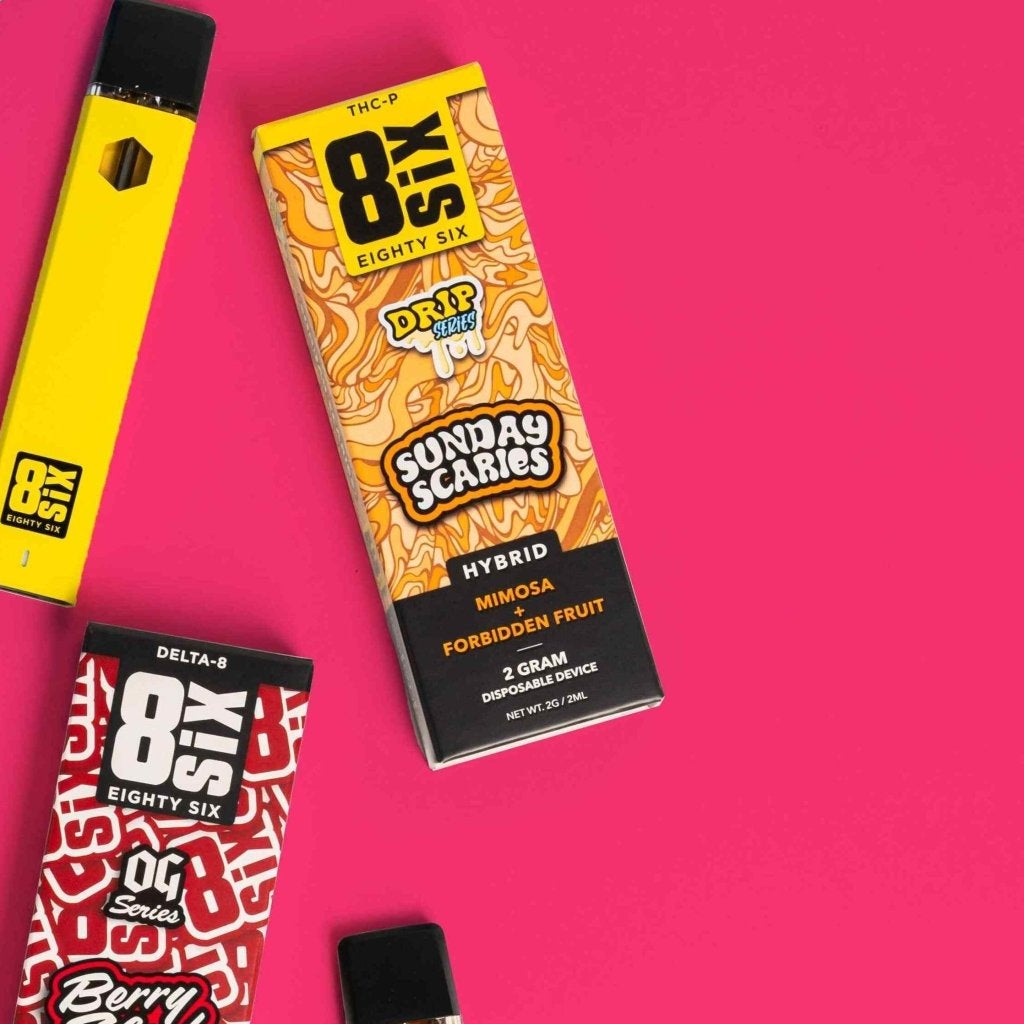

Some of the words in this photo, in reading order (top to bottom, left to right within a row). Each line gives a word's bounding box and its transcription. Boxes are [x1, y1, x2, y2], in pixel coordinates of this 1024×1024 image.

[347, 93, 399, 117] THC-P
[325, 130, 404, 245] 8
[358, 237, 427, 268] EIGHTY
[437, 226, 468, 244] SIX
[386, 282, 476, 340] DRIP
[9, 459, 47, 515] 8
[6, 514, 42, 528] EIGHTY
[45, 524, 61, 533] SIX
[462, 543, 548, 580] HYBRID
[475, 577, 556, 611] MIMOSA
[442, 615, 550, 657] FORBIDDEN
[553, 598, 605, 624] FRUIT
[156, 646, 227, 669] DELTA-8
[502, 668, 515, 681] 2
[517, 651, 569, 677] GRAM
[481, 674, 555, 703] DISPOSABLE
[555, 662, 599, 682] DEVICE
[506, 708, 526, 721] NET
[526, 702, 545, 715] WT.
[546, 697, 560, 710] 2G
[567, 691, 588, 704] 2ML
[111, 671, 185, 785] 8
[107, 787, 183, 811] EIGHTY
[188, 801, 222, 818] SIX
[124, 850, 185, 901] OG
[108, 895, 180, 924] Series
